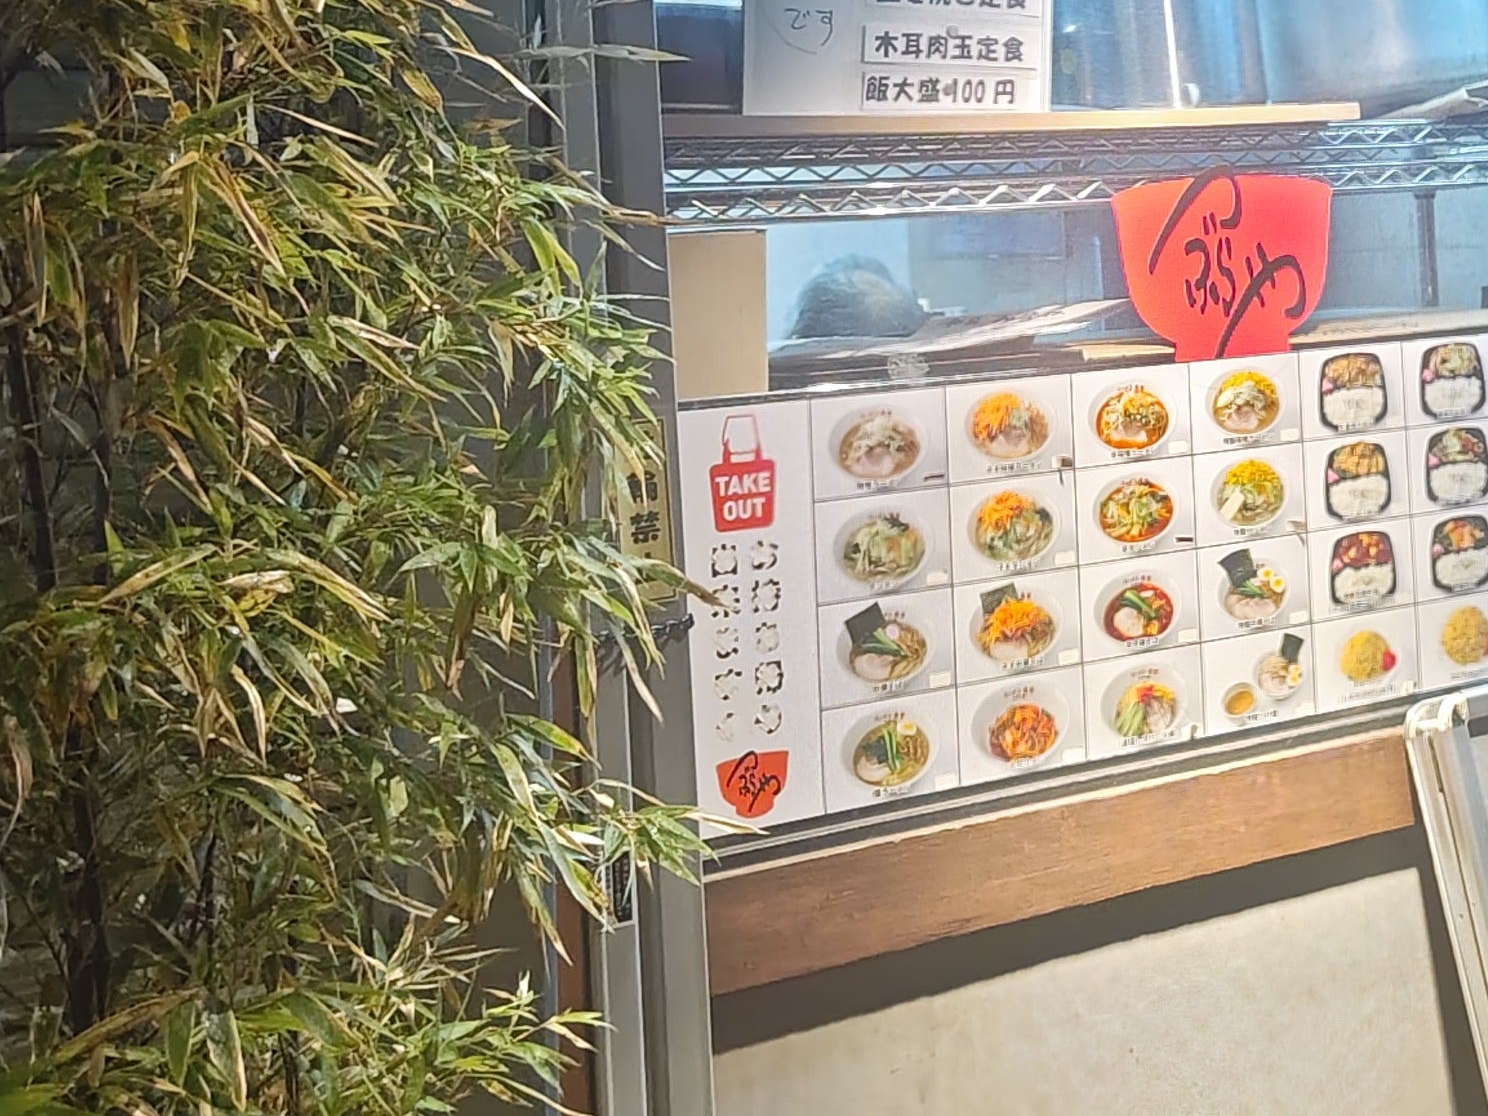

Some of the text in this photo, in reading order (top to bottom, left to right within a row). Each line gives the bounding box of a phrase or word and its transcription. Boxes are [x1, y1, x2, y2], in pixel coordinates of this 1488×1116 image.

[874, 30, 1025, 64] 木耳肉玉定食
[714, 470, 772, 497] TAKE
[722, 496, 766, 522] OUT
